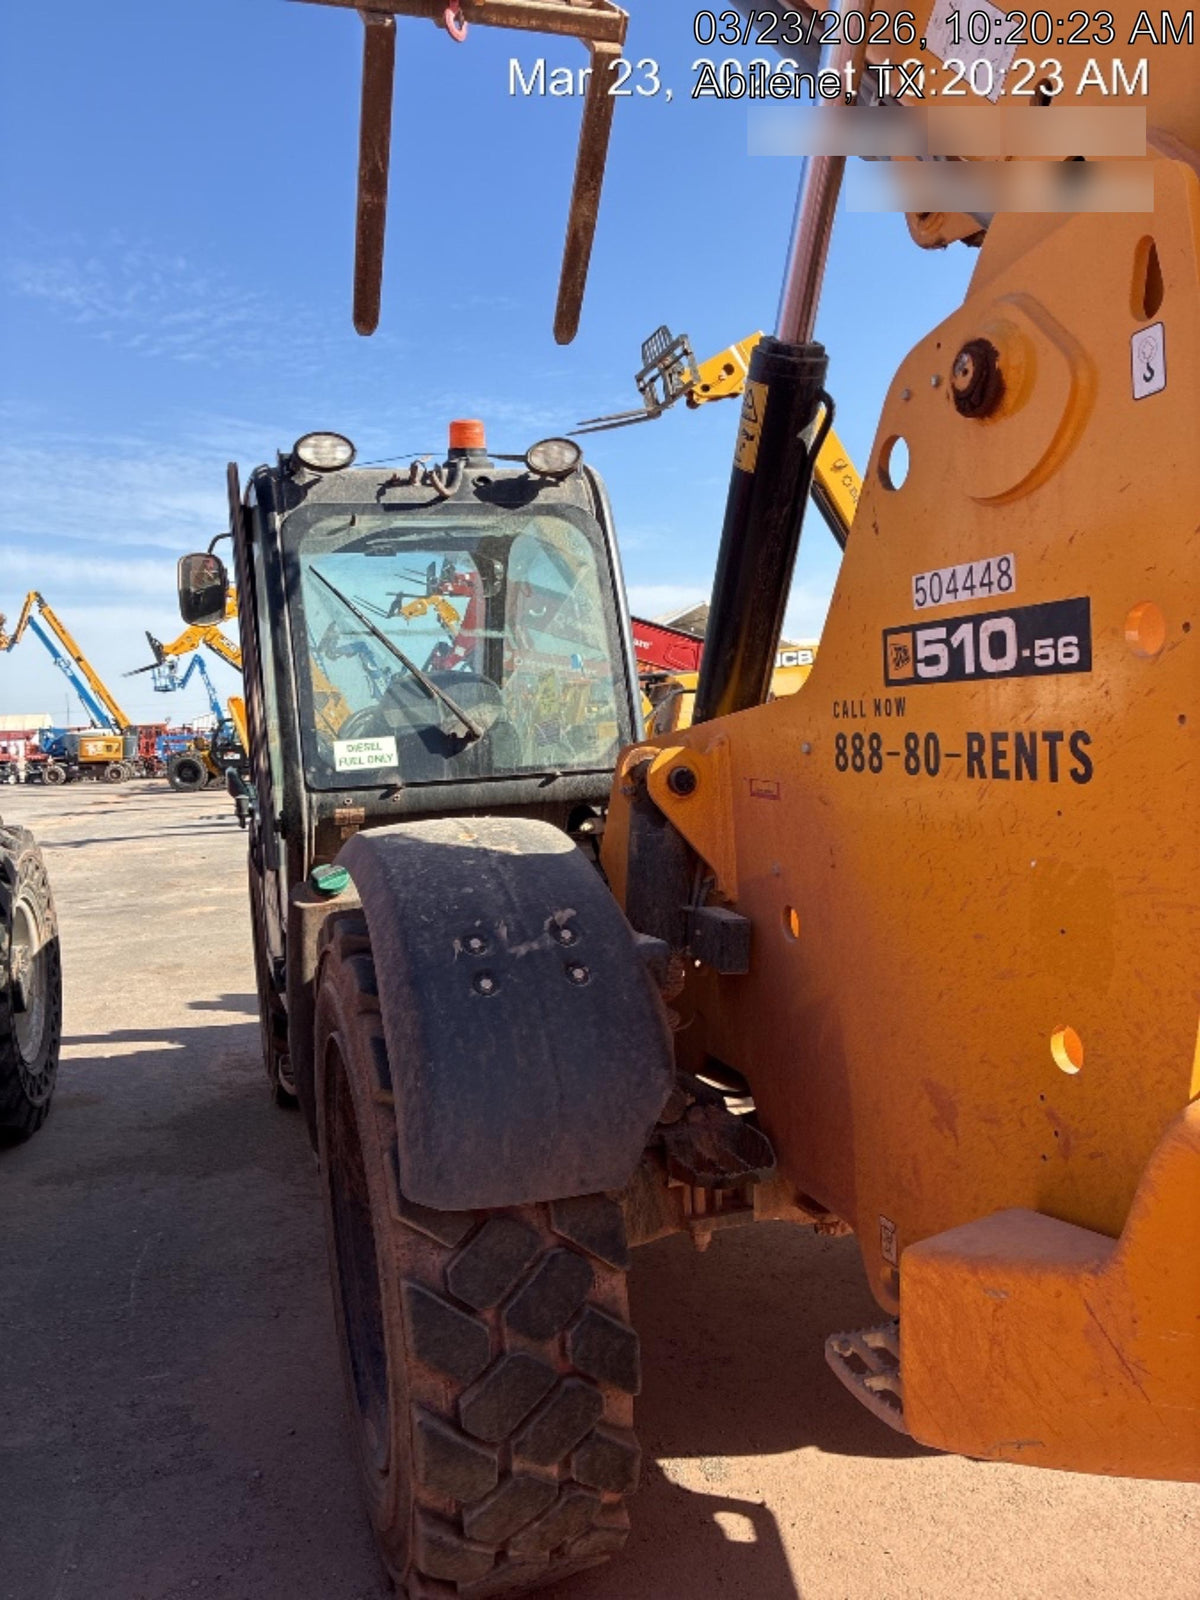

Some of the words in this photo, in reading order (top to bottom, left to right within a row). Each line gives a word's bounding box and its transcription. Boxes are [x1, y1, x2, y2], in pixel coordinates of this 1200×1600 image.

[914, 556, 1013, 607] 504448
[833, 699, 866, 719] CALL
[874, 697, 907, 717] NOW
[346, 742, 383, 753] DIESEL
[834, 730, 1093, 784] 888-80-RENTS
[339, 756, 364, 767] FUEL
[367, 753, 394, 764] ONLY
